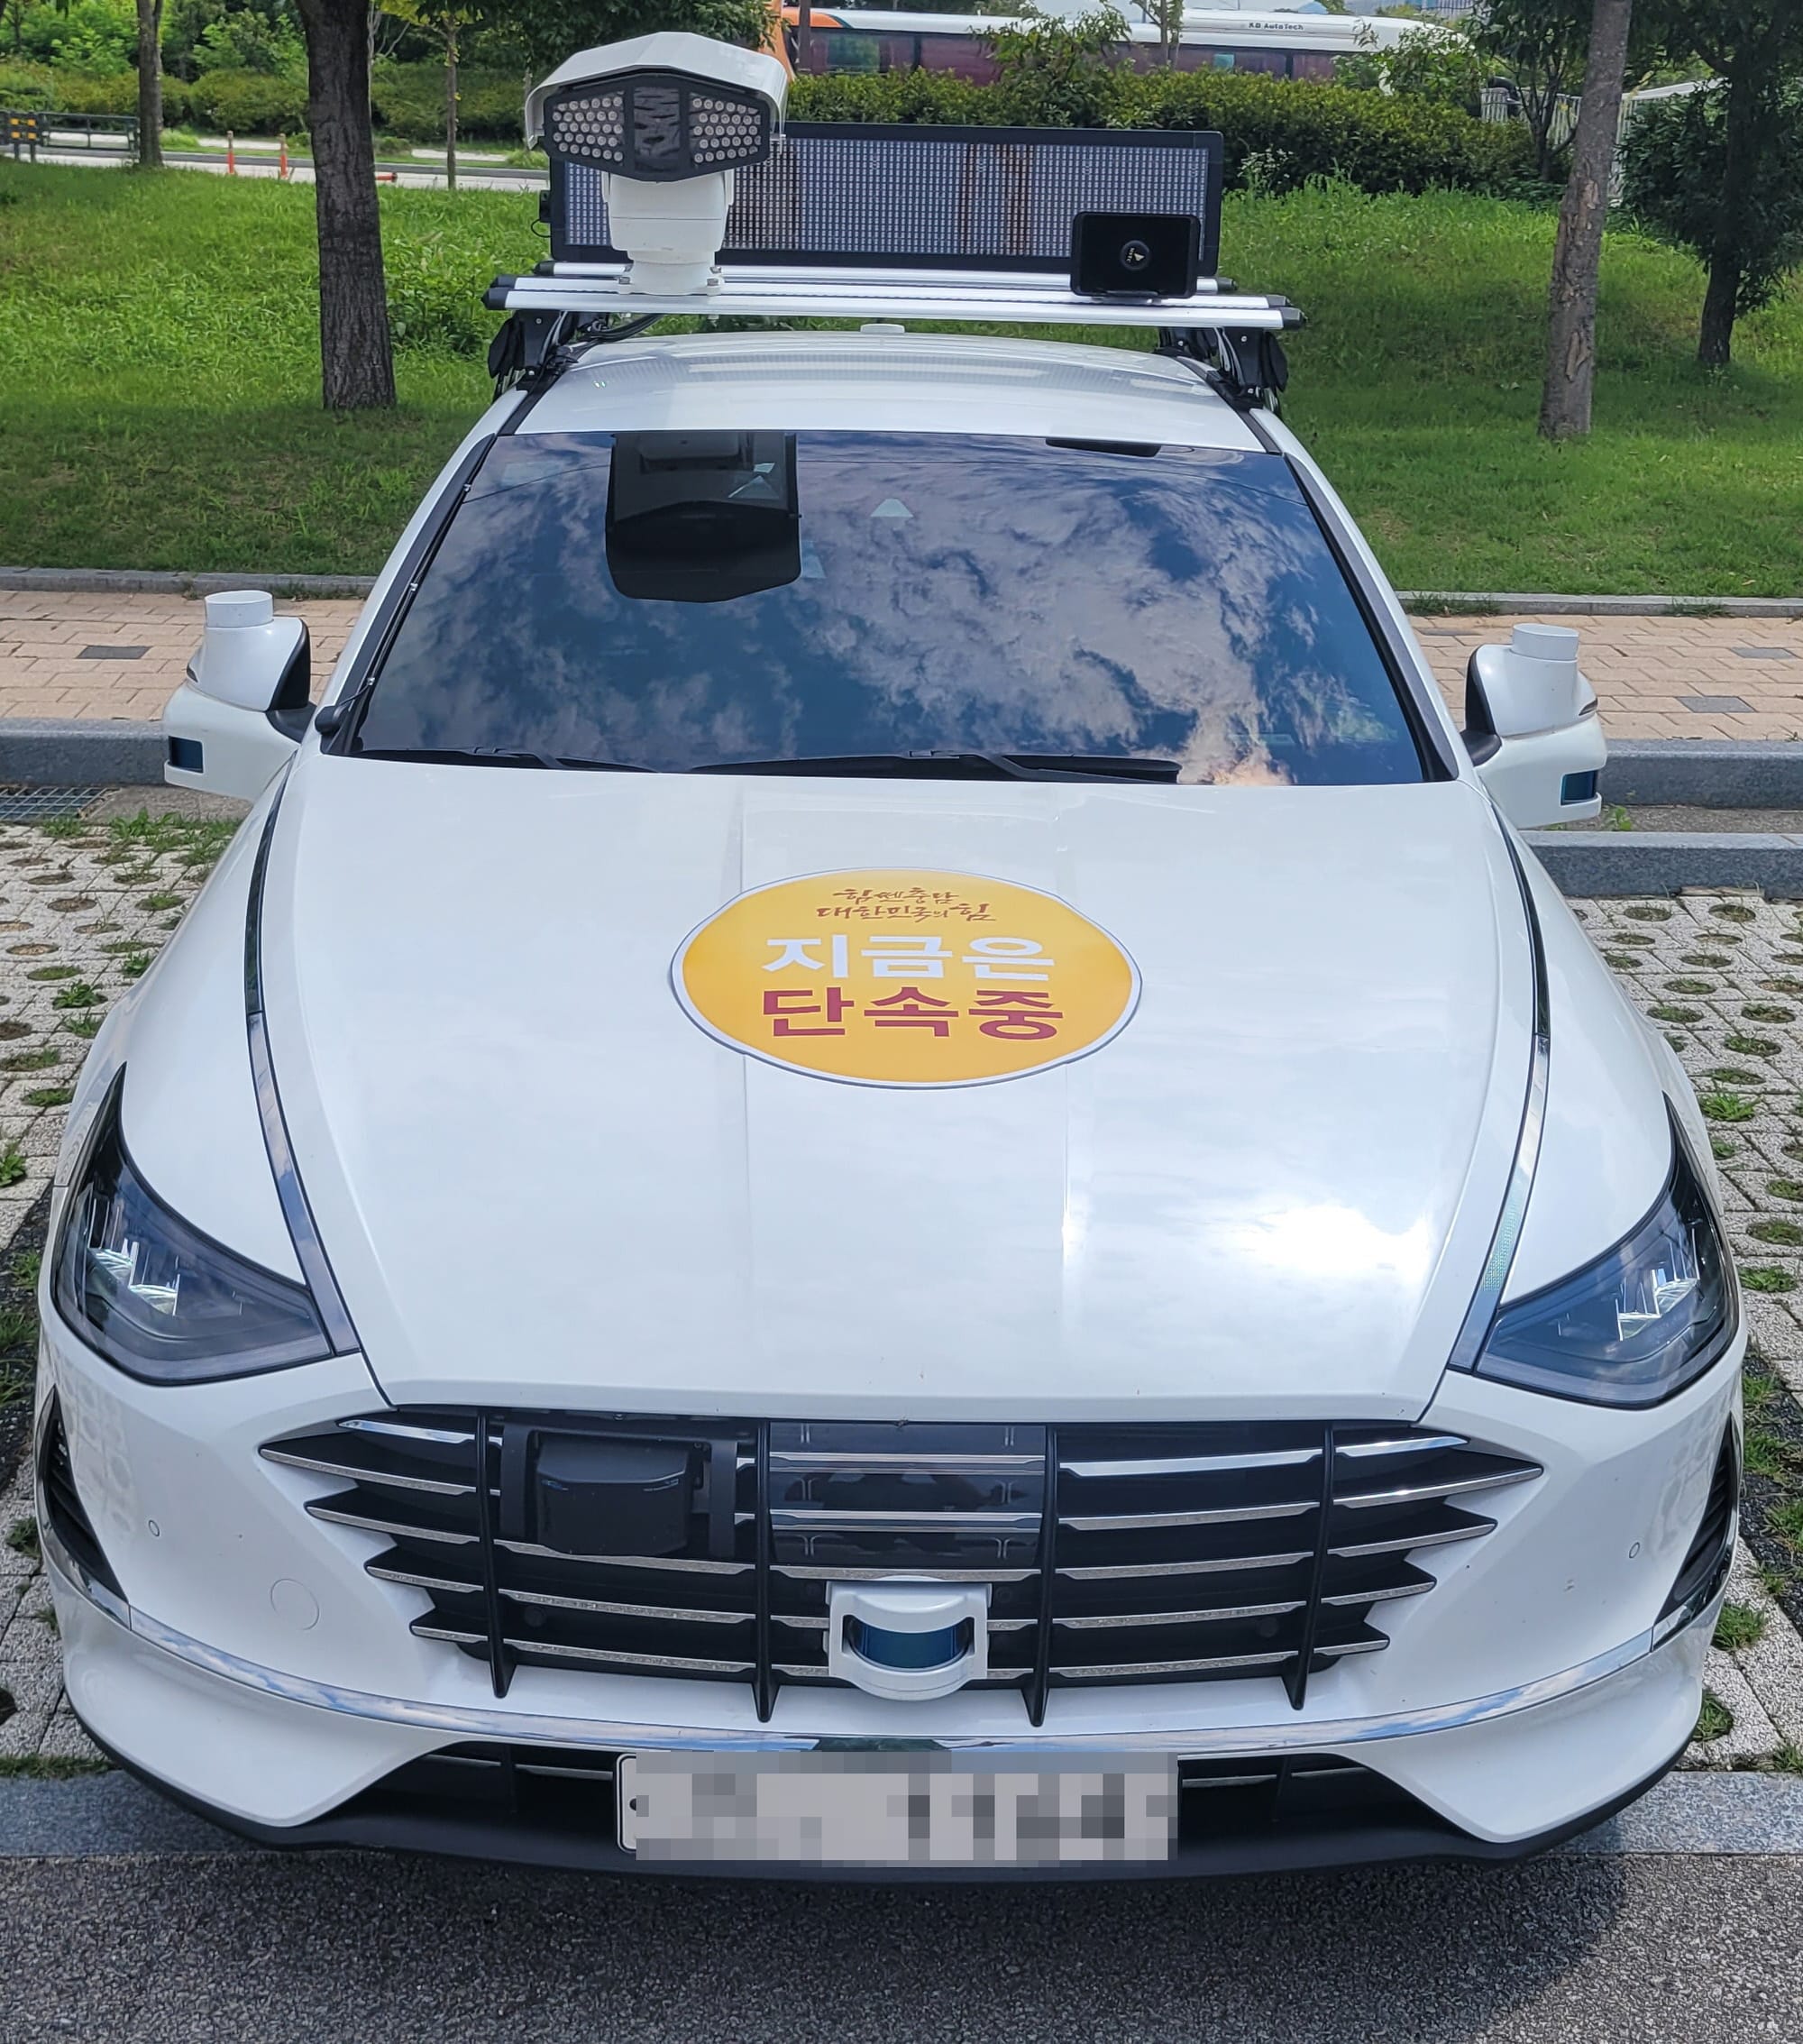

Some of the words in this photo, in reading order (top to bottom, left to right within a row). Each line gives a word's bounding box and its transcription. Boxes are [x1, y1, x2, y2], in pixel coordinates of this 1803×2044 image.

[949, 903, 996, 921] 힘
[762, 934, 1055, 981] 지금은
[763, 986, 1064, 1040] 단속중
